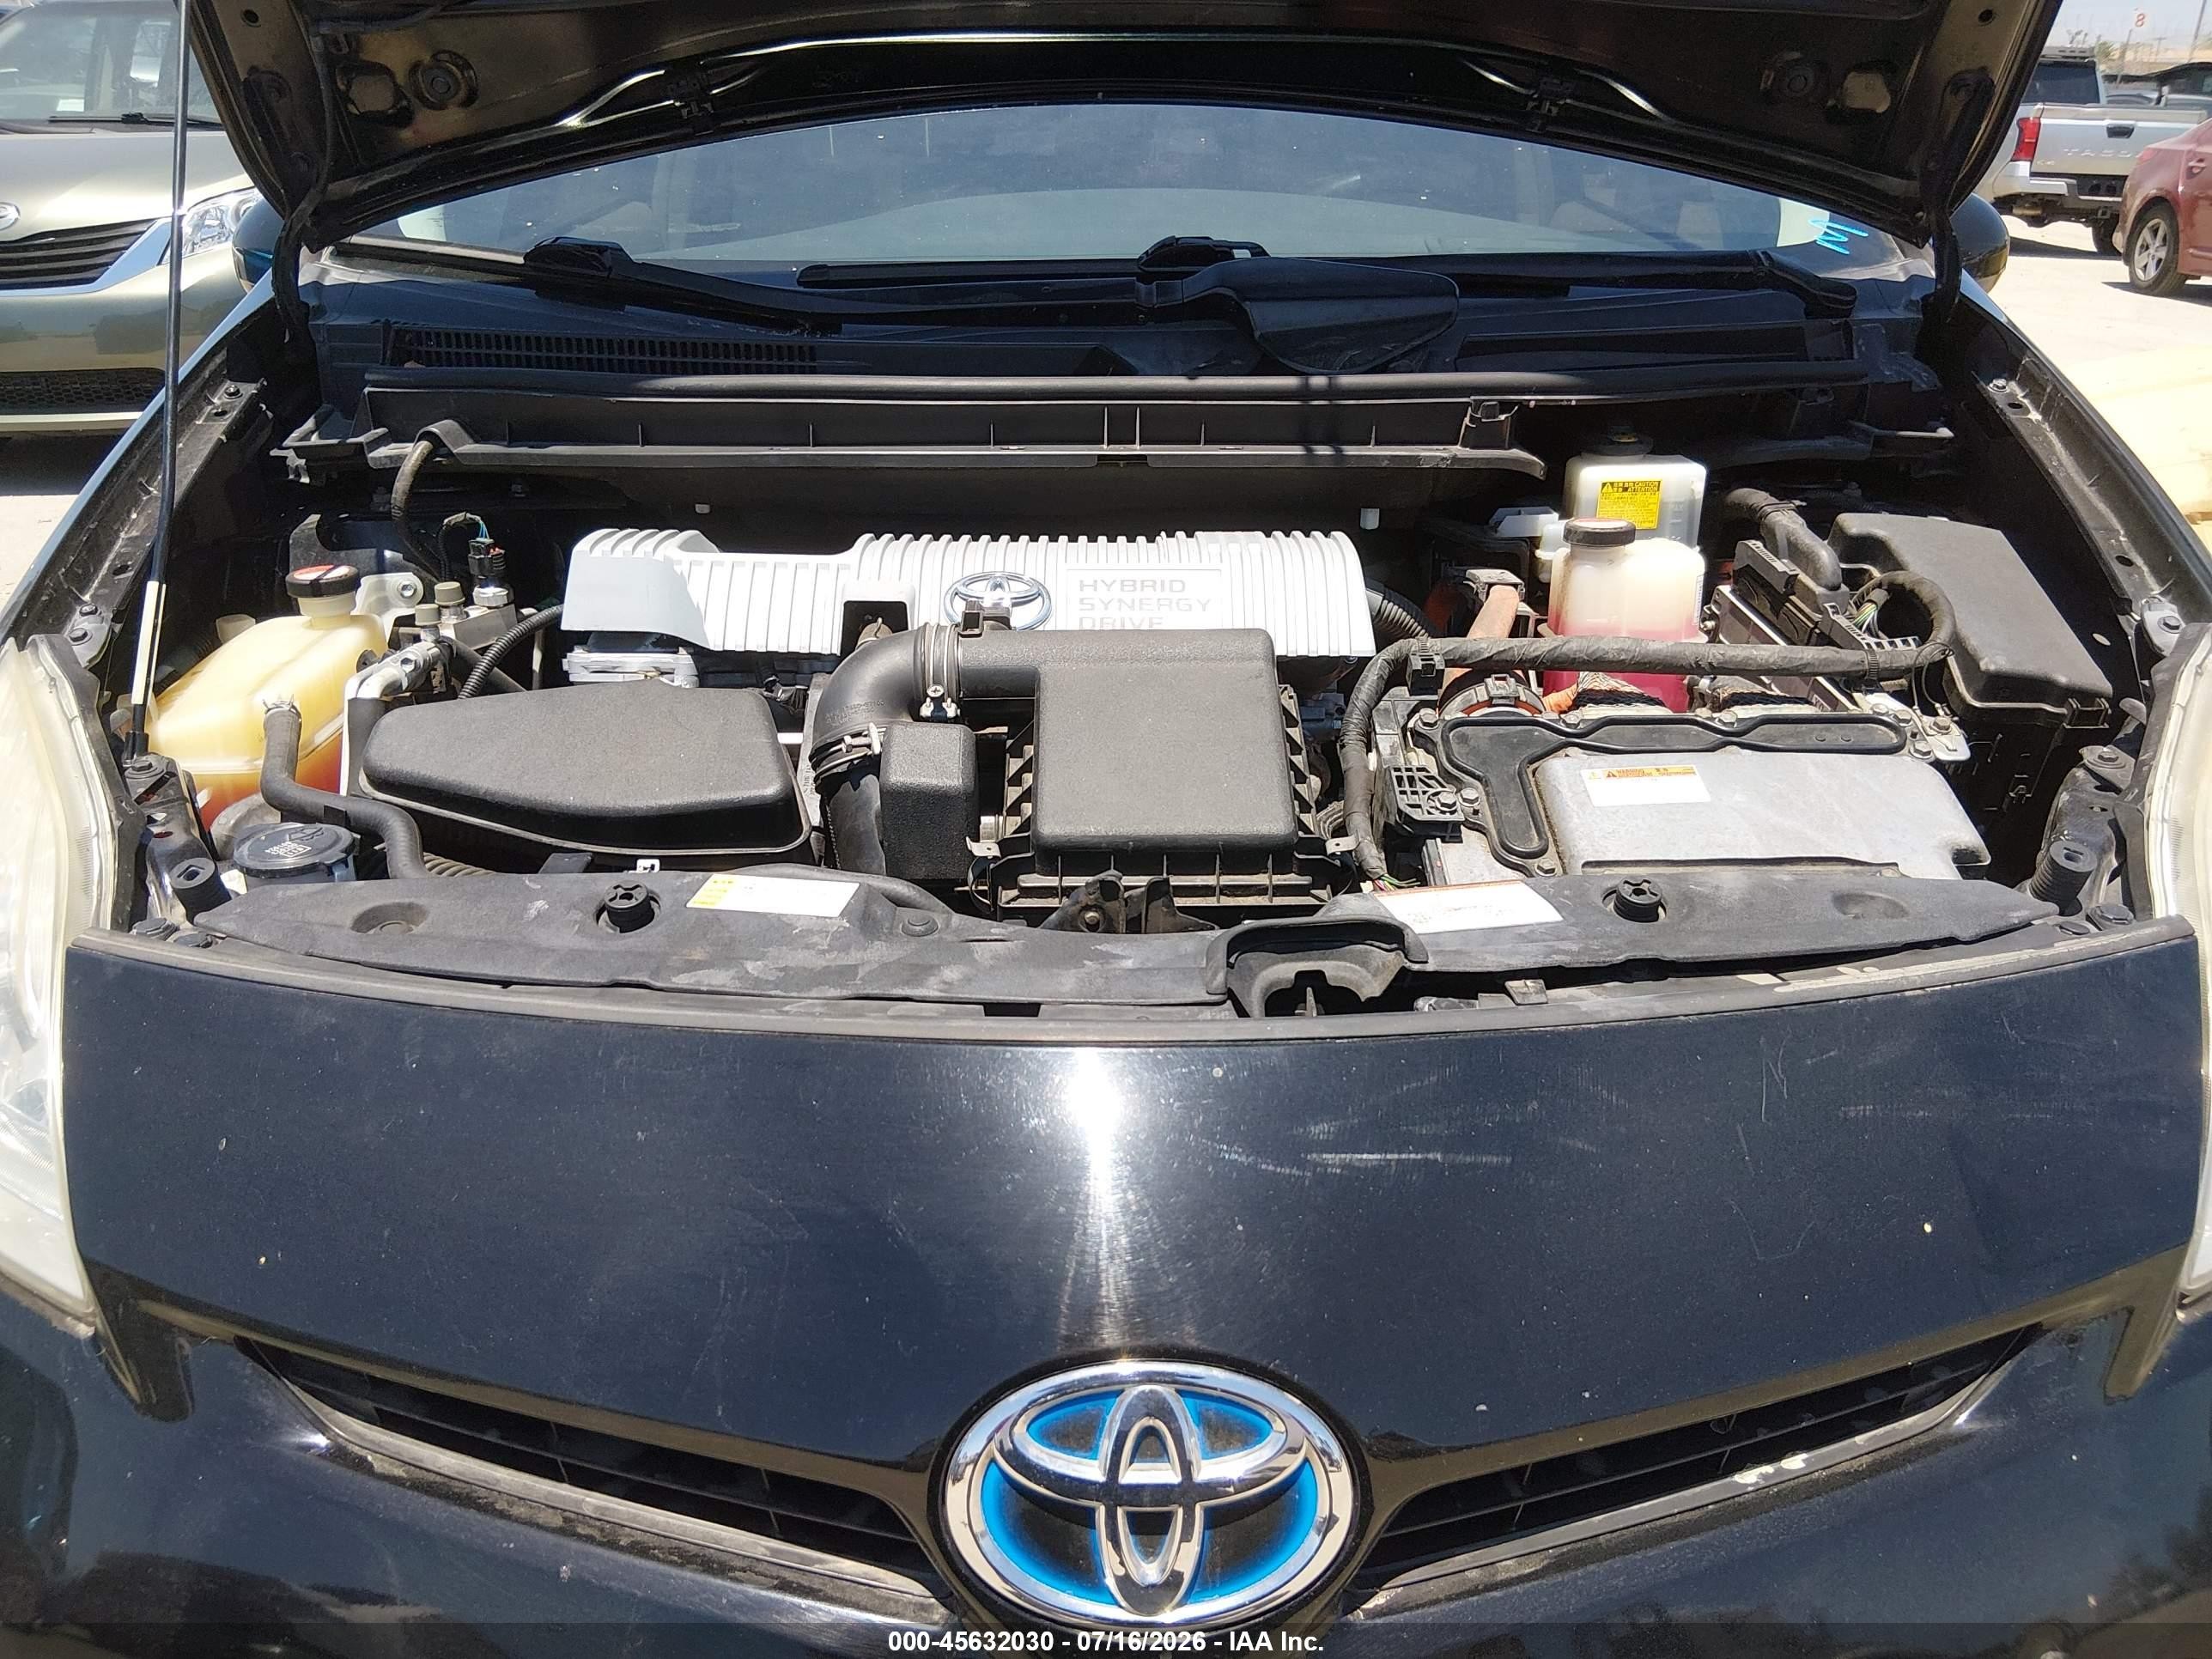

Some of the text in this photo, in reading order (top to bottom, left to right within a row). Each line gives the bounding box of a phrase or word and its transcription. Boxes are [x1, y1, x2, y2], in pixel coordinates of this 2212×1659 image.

[1079, 580, 1186, 592] HYBRID
[1079, 598, 1212, 611] SYNERGY
[1079, 617, 1164, 629] DRIVE
